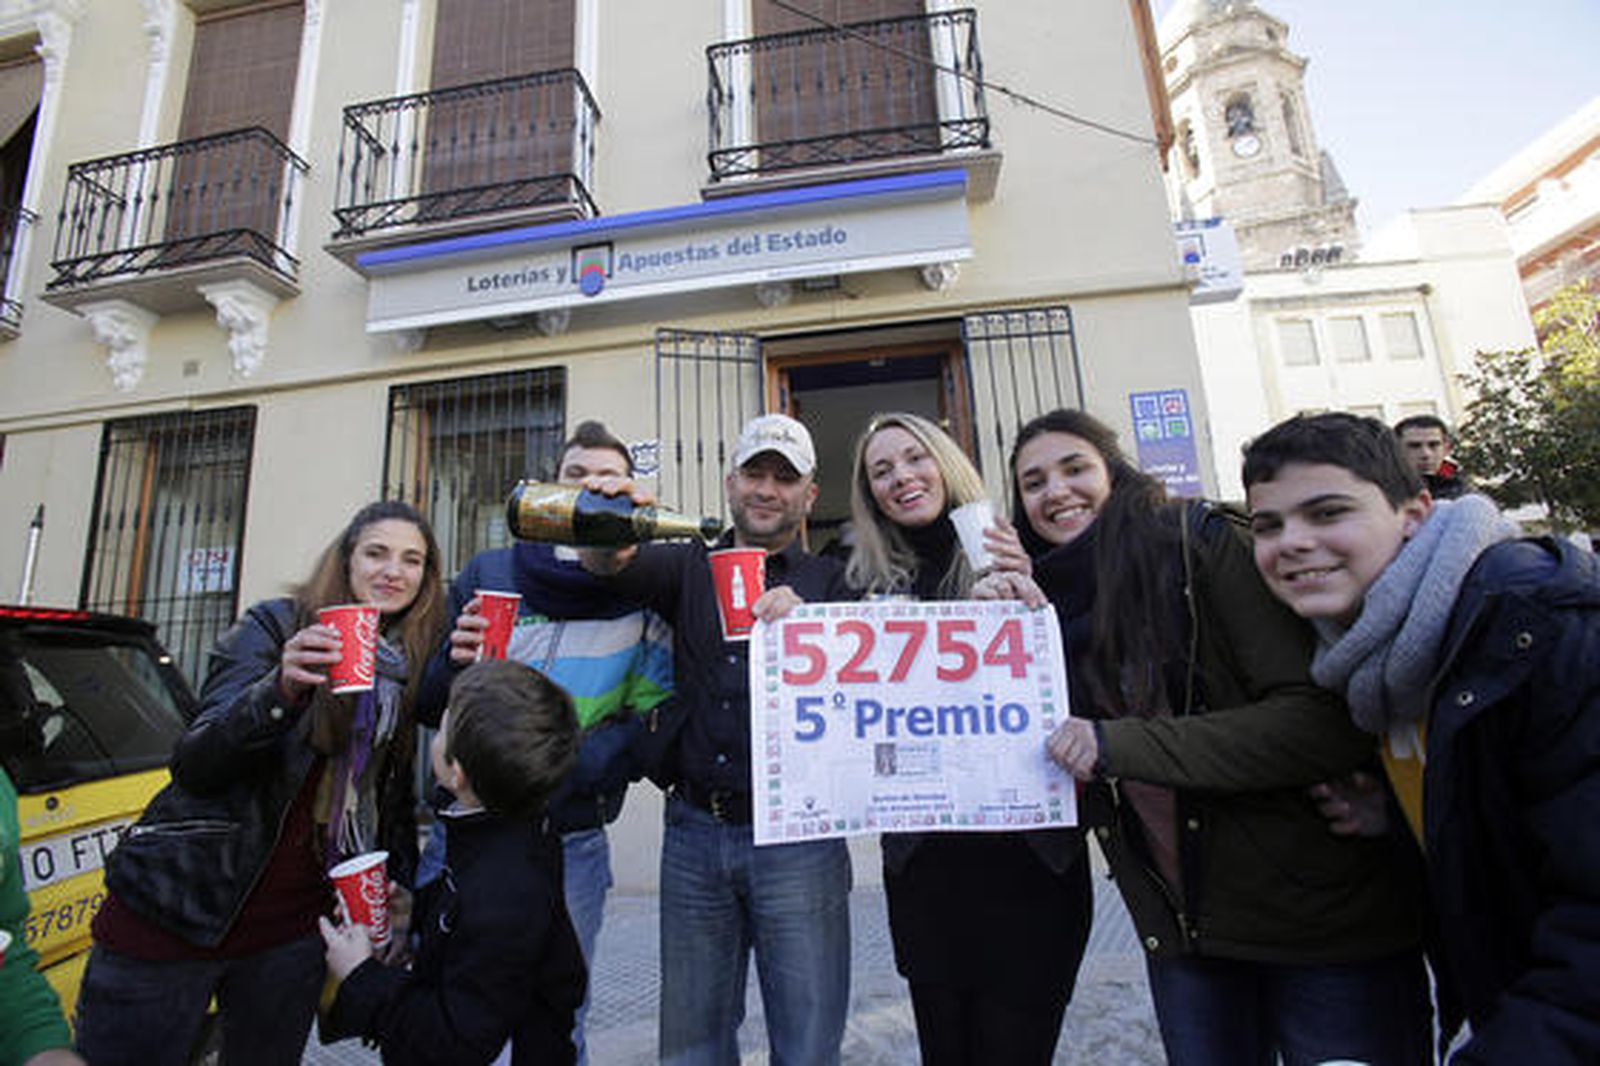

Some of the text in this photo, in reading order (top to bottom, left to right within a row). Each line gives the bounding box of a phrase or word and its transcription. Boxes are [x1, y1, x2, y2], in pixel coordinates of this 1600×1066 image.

[618, 226, 848, 272] Apuestas del Estado
[467, 265, 568, 292] Loterías y
[782, 618, 1034, 686] 52754
[855, 693, 1031, 739] Premio
[71, 825, 125, 869] FT
